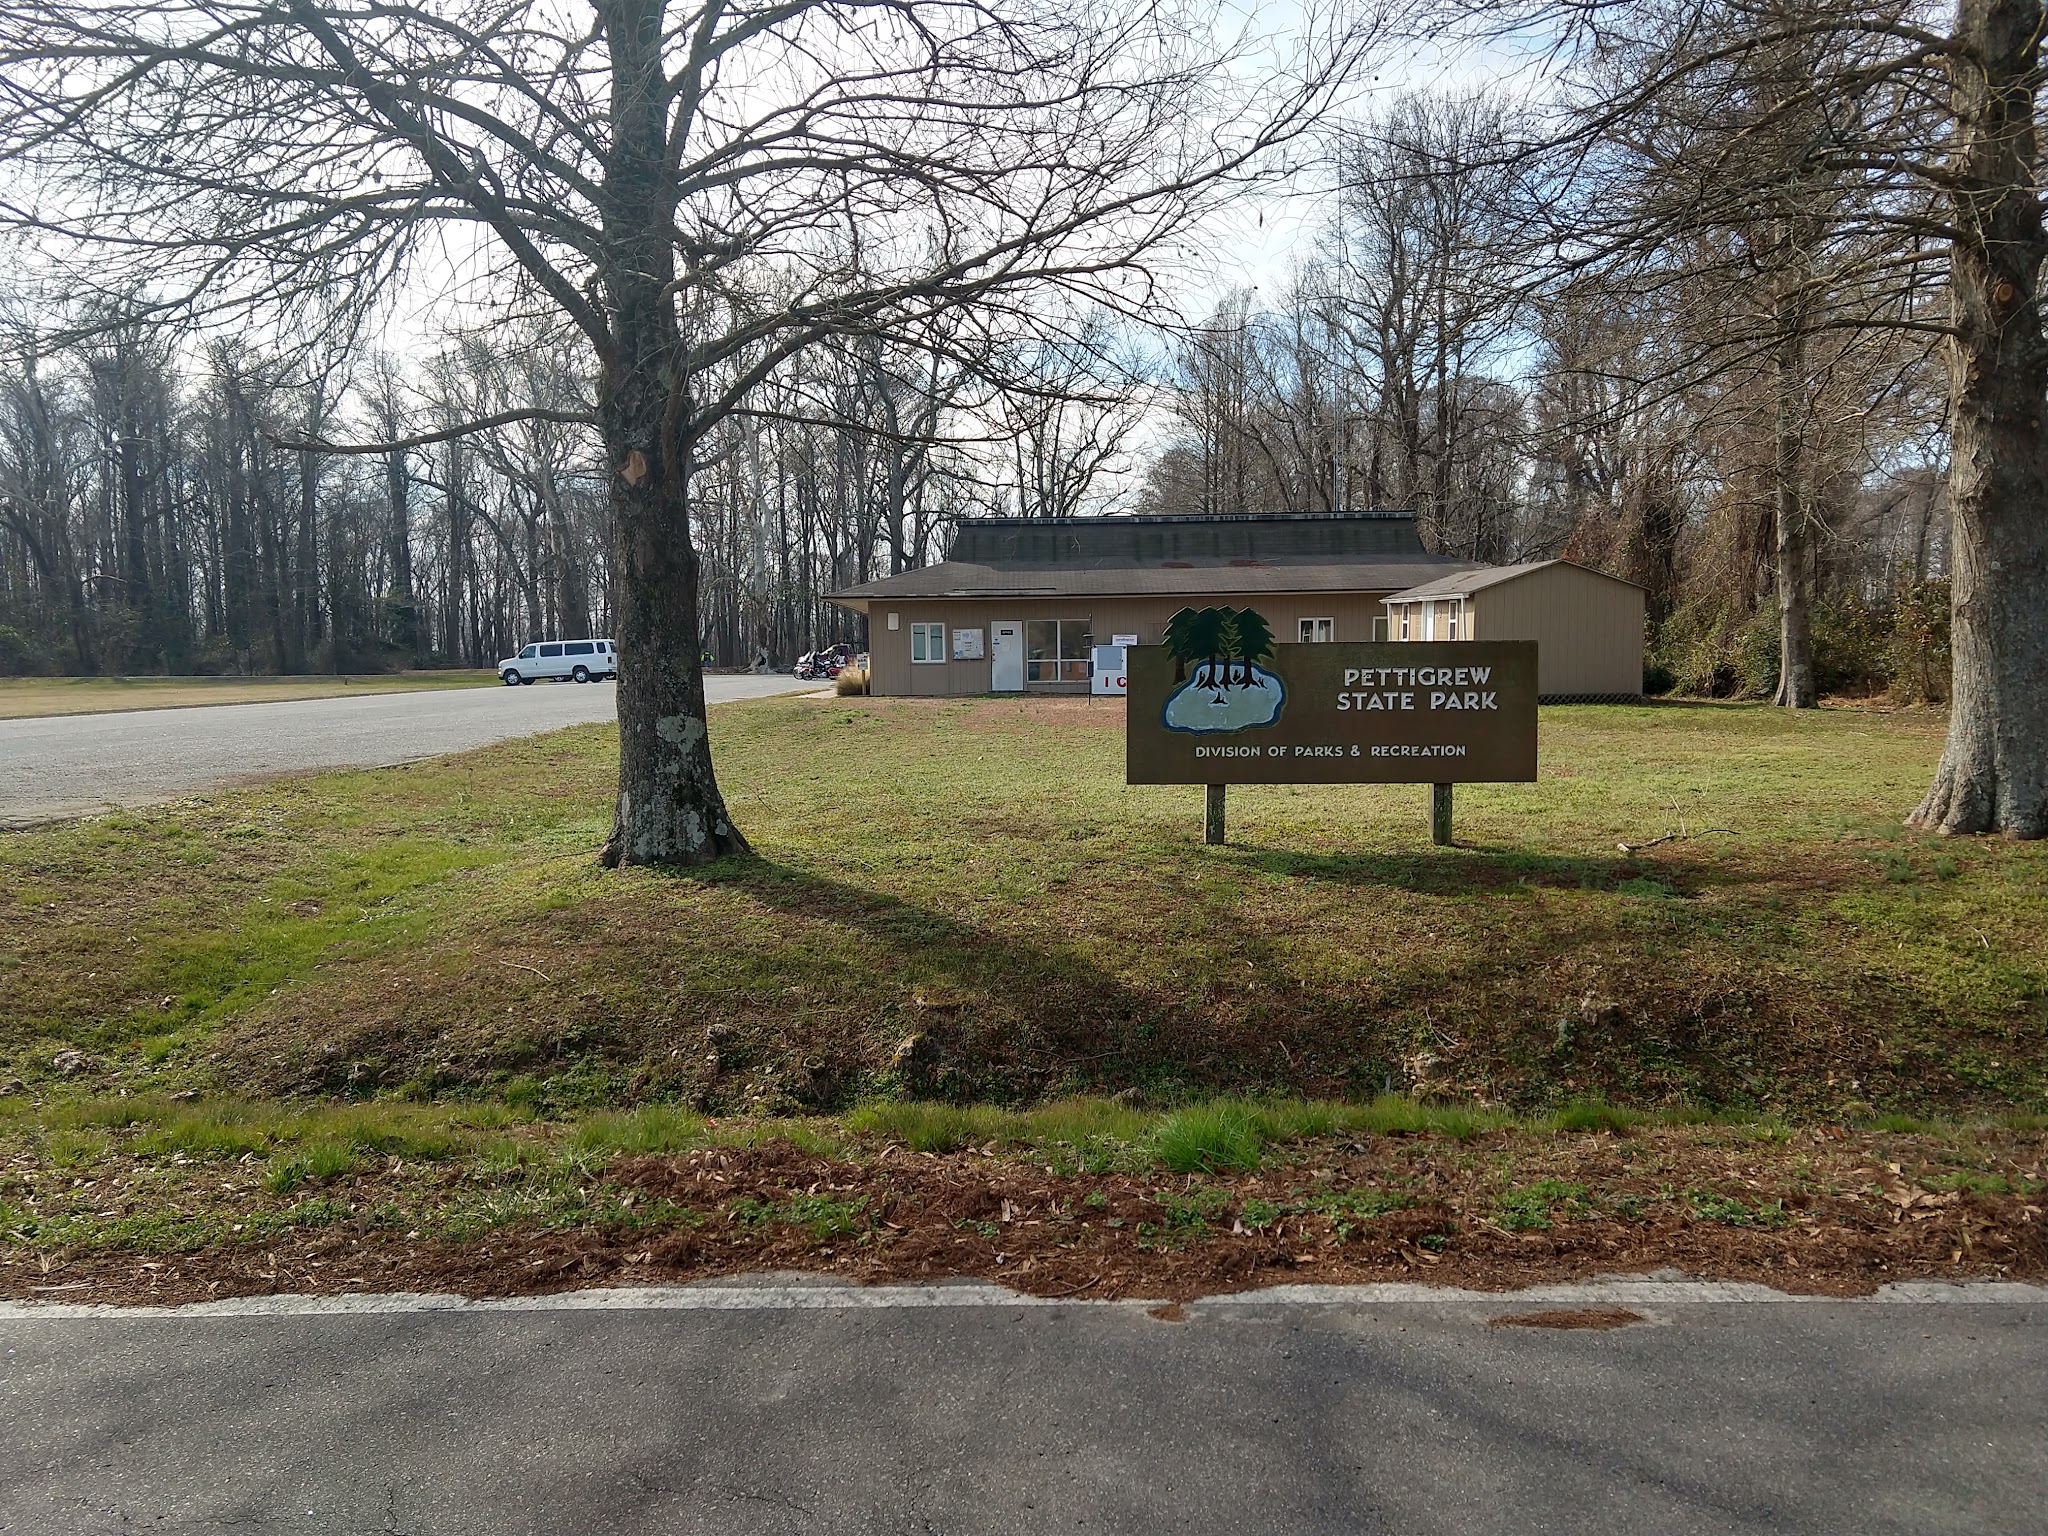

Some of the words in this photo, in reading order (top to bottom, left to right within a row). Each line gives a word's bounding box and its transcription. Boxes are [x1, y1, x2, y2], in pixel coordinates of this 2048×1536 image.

[1344, 666, 1491, 686] PETTIGREW
[1336, 691, 1415, 710] STATE
[1430, 691, 1499, 710] PARK
[1195, 746, 1261, 757] DIVISION
[1267, 746, 1288, 757] OF
[1294, 746, 1344, 757] PARKS
[1350, 745, 1361, 757] &
[1371, 745, 1466, 757] RECREATION
